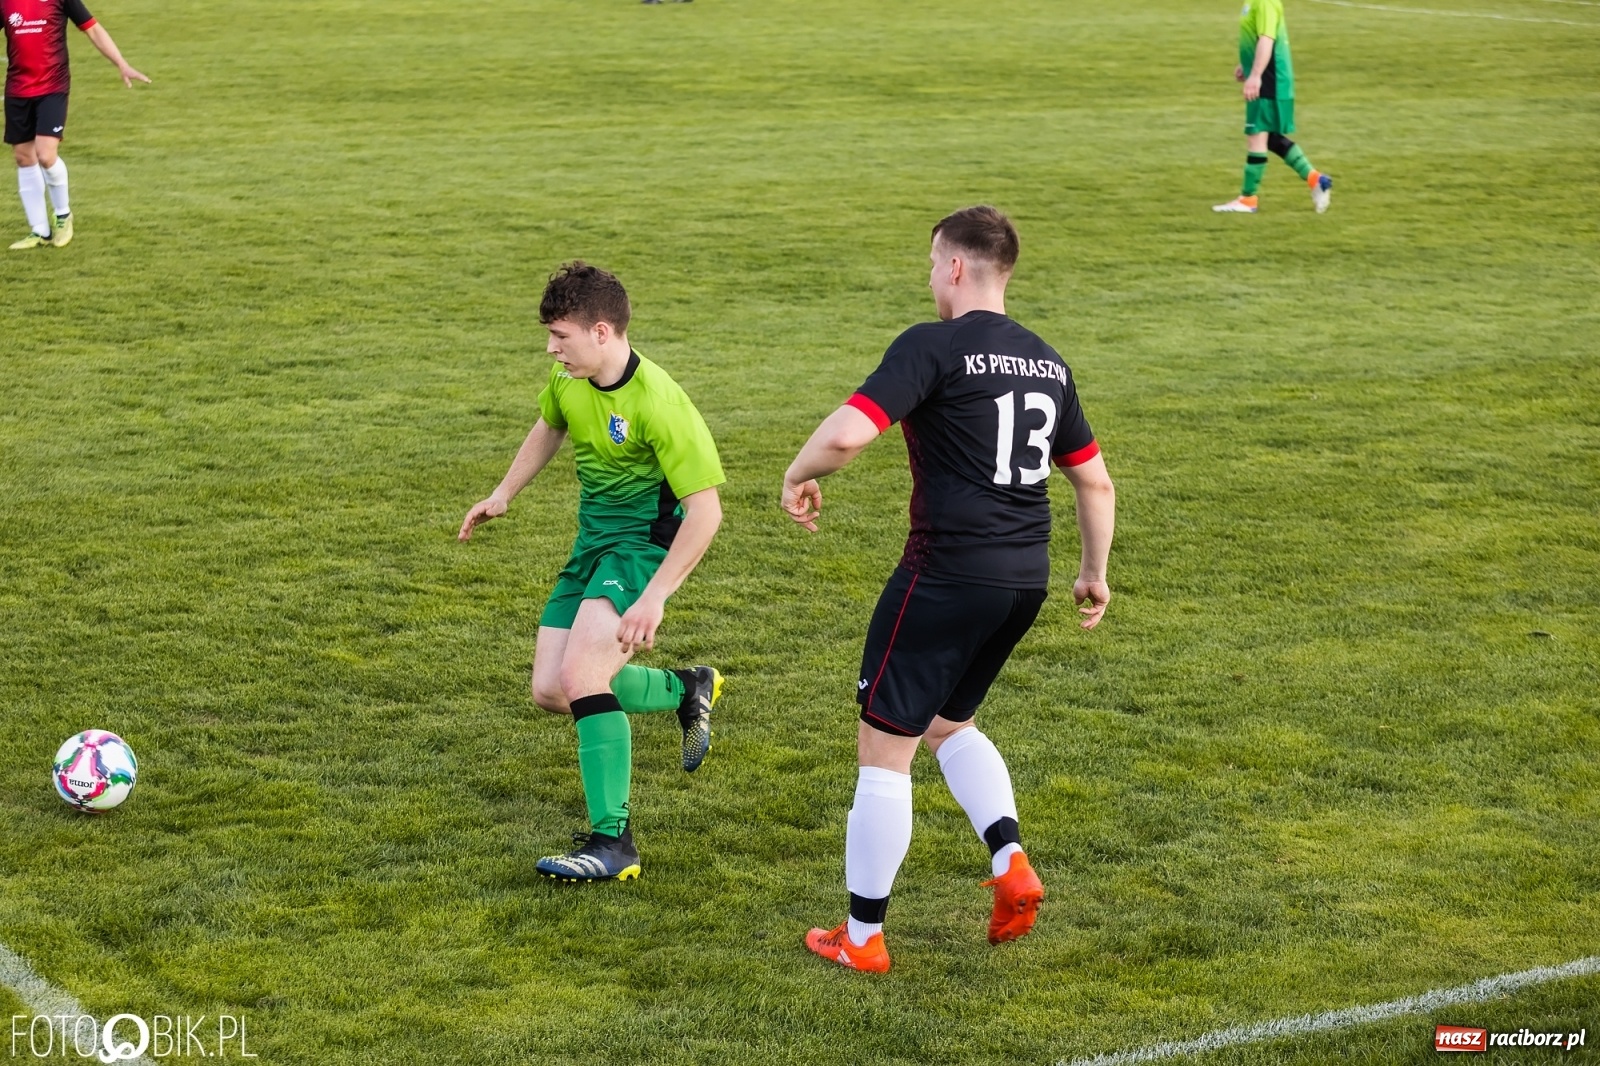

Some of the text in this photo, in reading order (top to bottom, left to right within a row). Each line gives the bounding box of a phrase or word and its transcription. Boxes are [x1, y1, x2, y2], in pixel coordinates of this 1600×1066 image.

[964, 354, 1067, 386] KS PIETRASZYN
[993, 390, 1057, 485] 13
